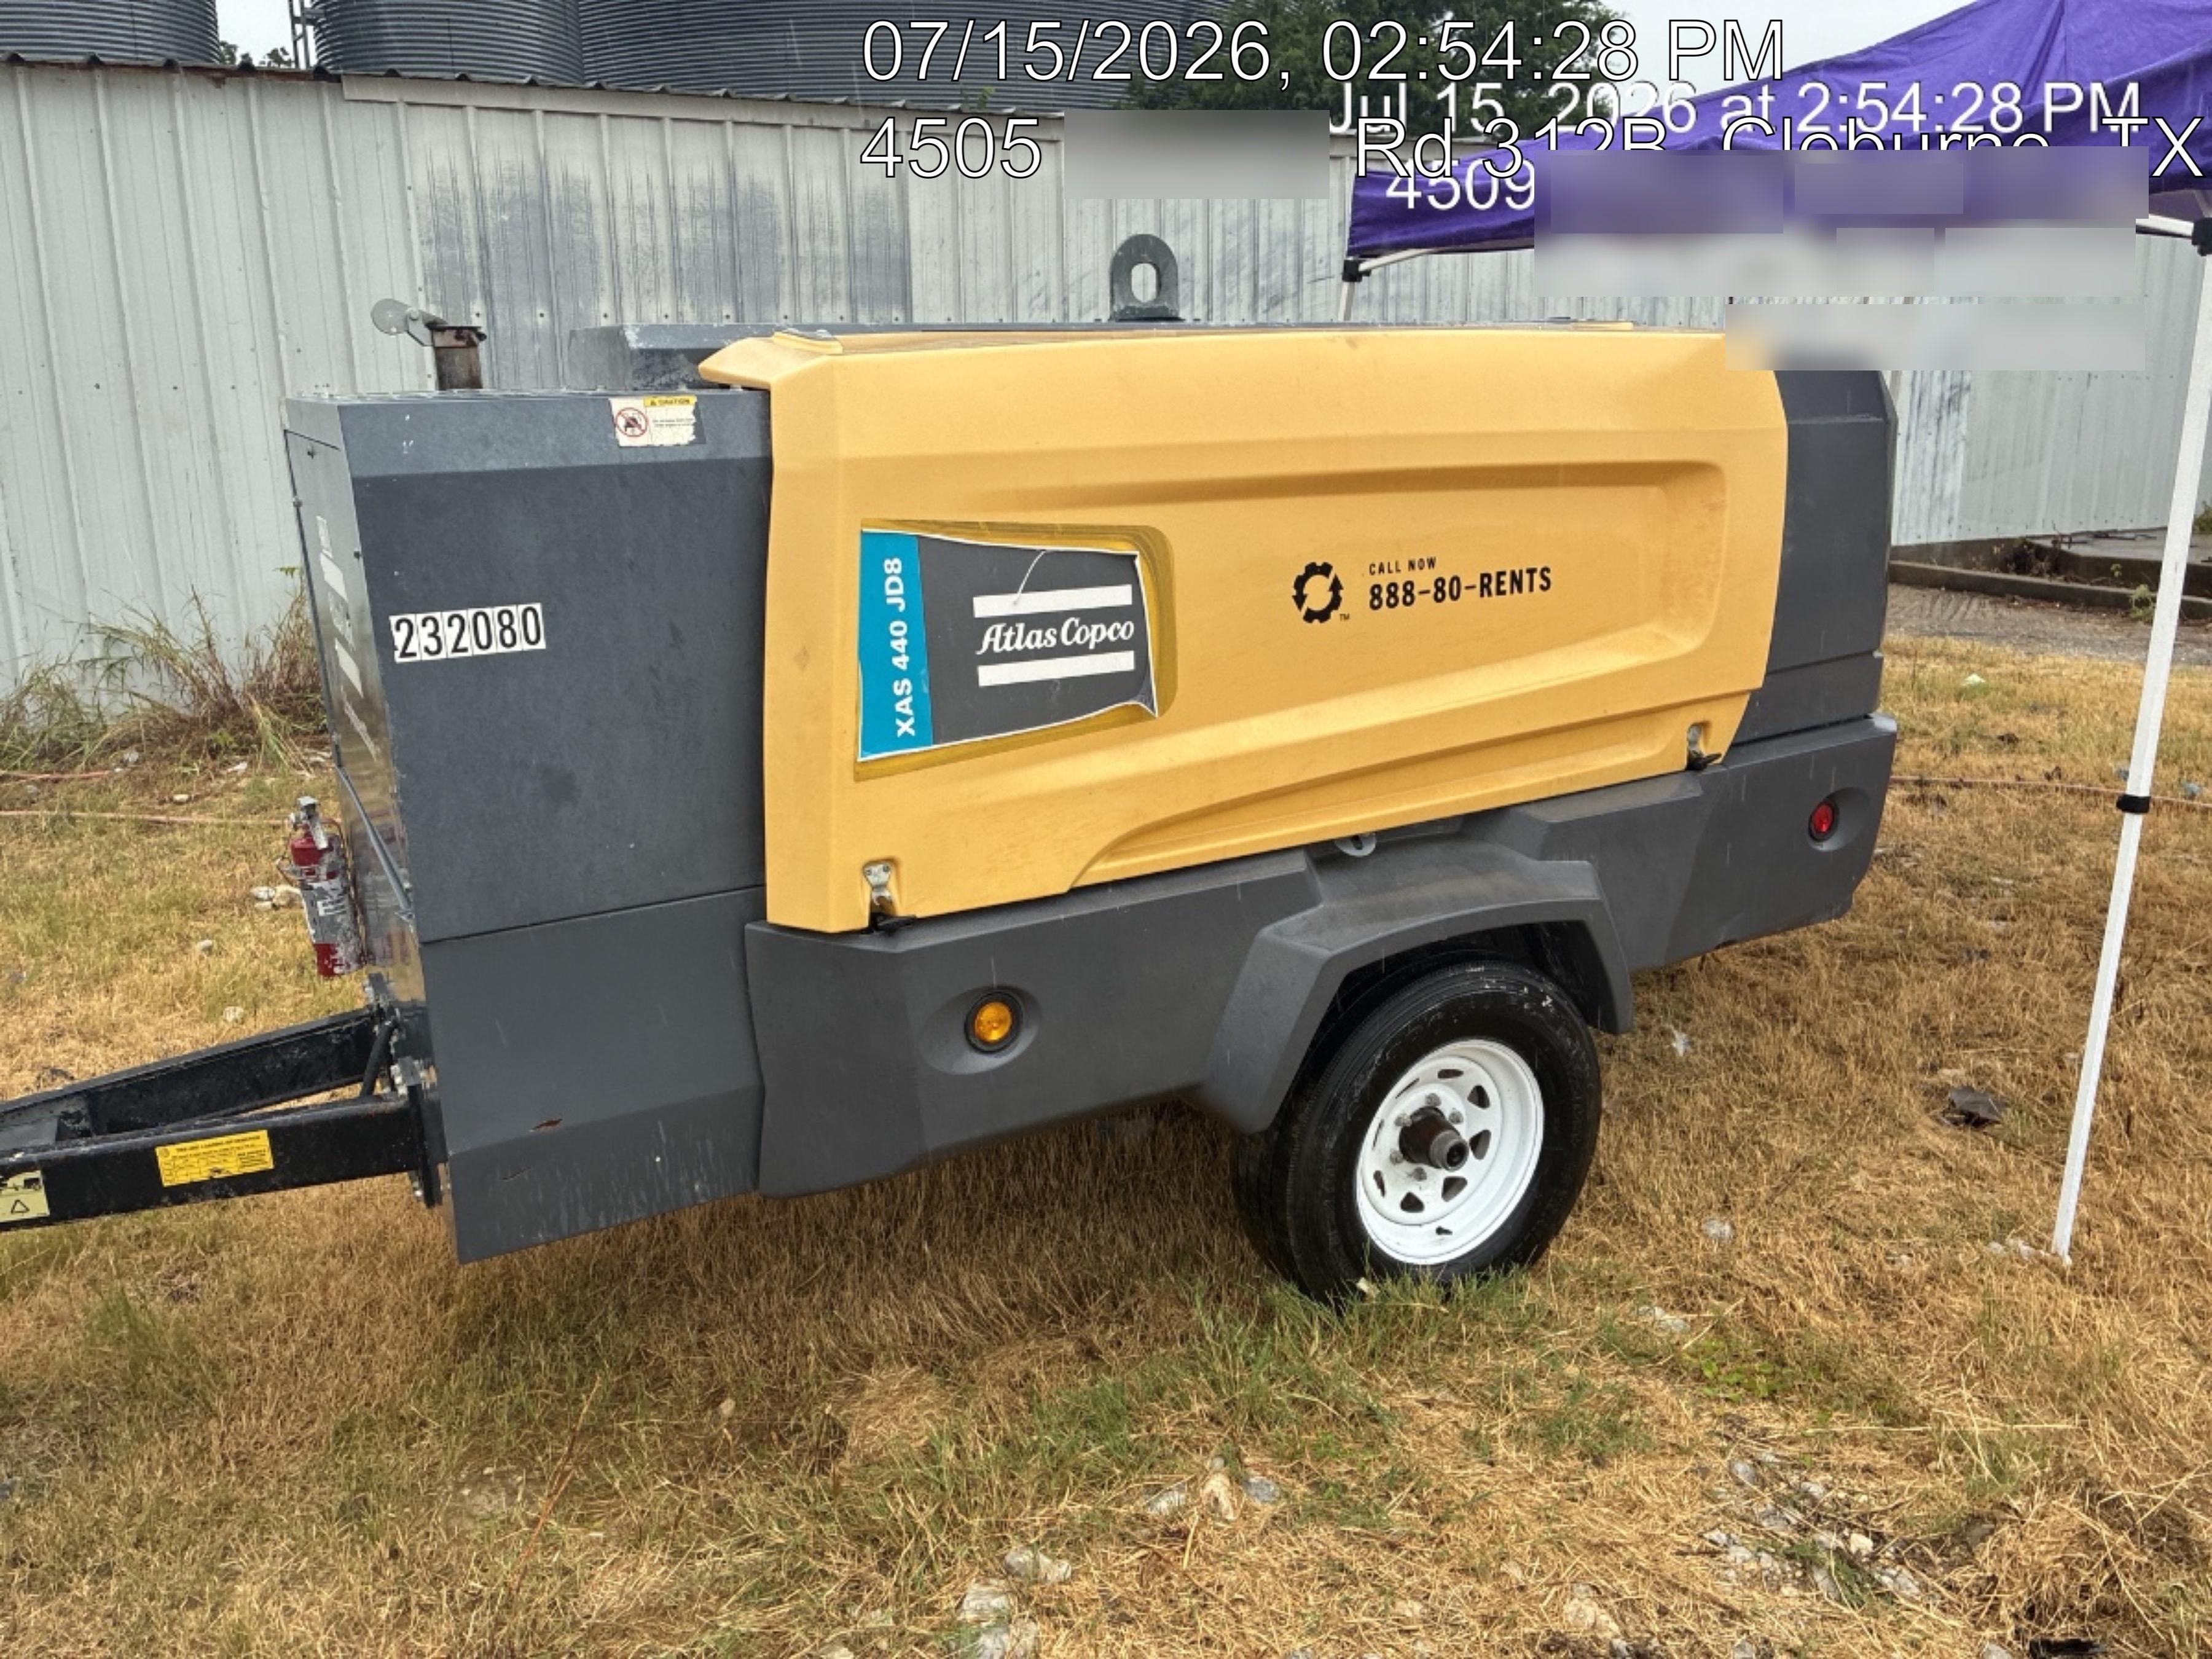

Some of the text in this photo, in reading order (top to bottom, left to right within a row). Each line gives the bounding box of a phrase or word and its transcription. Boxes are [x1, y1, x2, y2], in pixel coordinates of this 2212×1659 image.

[1369, 556, 1437, 576] CALL NOW
[1369, 567, 1551, 610] 888-80-RENTS
[394, 606, 541, 659] 232080
[884, 557, 916, 737] XAS 440 JD8
[976, 617, 1134, 655] Atlas Copco
